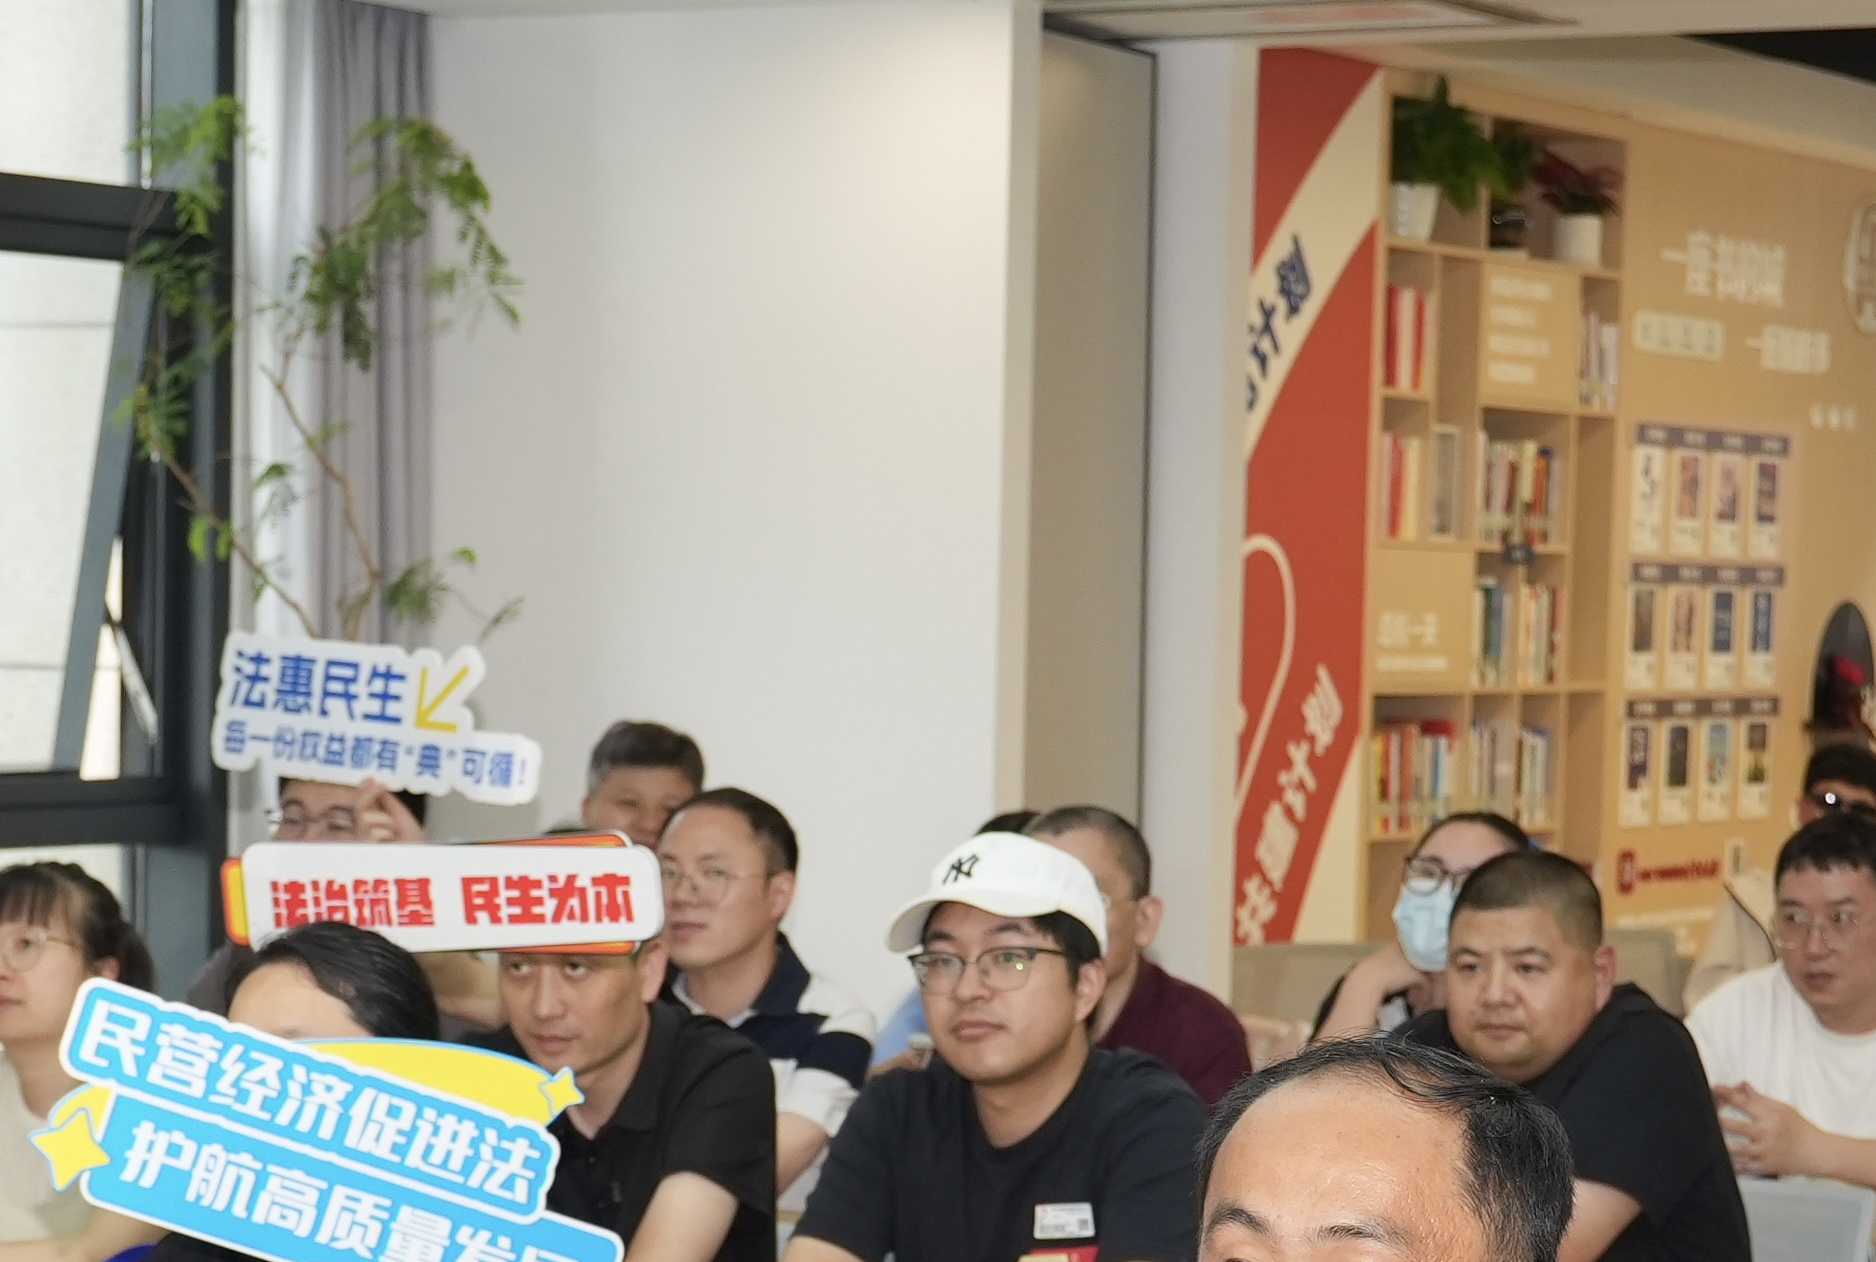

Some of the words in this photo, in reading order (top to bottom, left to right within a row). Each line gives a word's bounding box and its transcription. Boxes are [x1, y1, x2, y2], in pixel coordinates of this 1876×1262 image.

[230, 650, 408, 725] 法惠民生
[270, 877, 435, 929] 法治筑基
[461, 873, 635, 925] 民生为本
[78, 1001, 546, 1206] 民营经济促进法
